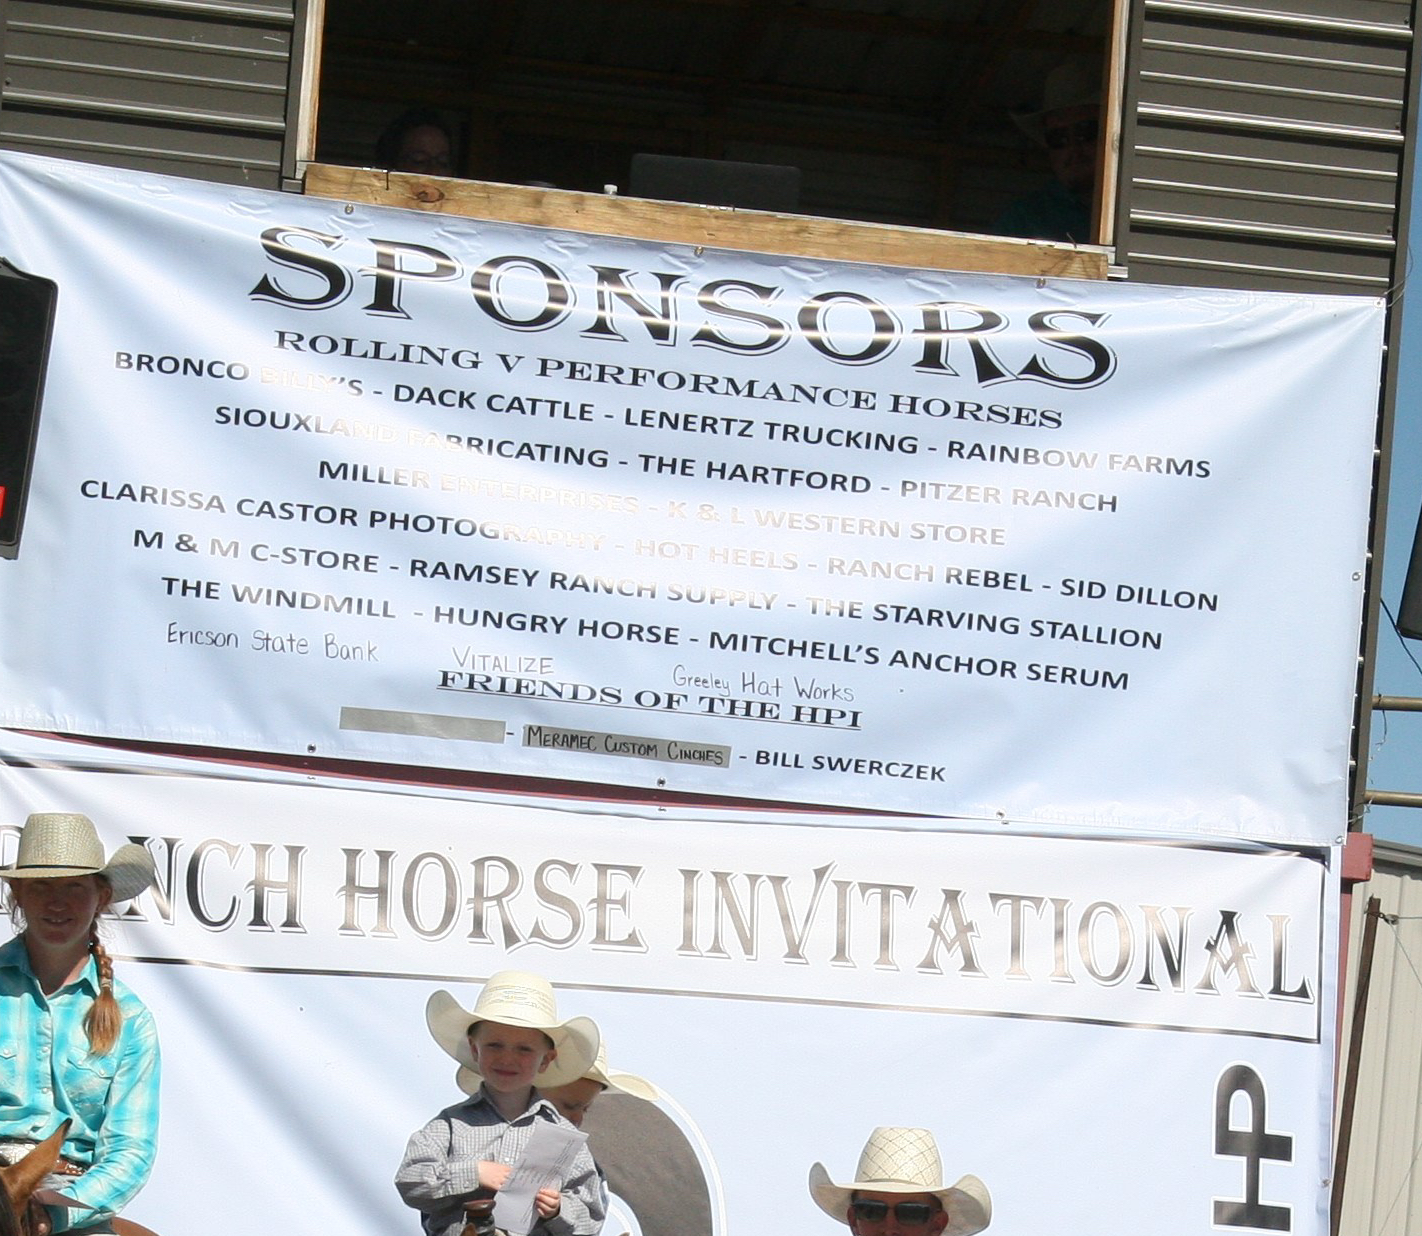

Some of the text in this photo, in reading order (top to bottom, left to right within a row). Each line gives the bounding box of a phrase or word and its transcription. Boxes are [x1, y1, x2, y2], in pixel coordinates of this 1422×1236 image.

[248, 226, 1119, 390] SPONSORS
[114, 349, 250, 384] BRONCO
[393, 382, 476, 412] DACK
[486, 392, 595, 423] CATTLE
[624, 406, 754, 439] LENERTZ
[762, 420, 920, 455] TRUCKING
[947, 438, 1098, 474] RAINBOW
[1108, 450, 1212, 481] FARMS
[273, 328, 1064, 432] ROLLING V PERFORMANCE HORSES
[213, 404, 398, 444] SIOUXLAND
[405, 427, 609, 470] FABRICATING
[638, 452, 696, 478] THE
[705, 459, 872, 496] HARTFORD
[900, 477, 1002, 508] PITZER
[1012, 484, 1118, 515] RANCH
[317, 459, 430, 490] MILLER
[668, 499, 687, 520] K
[697, 502, 721, 523] &
[731, 506, 745, 525] L
[753, 507, 900, 540] WESTERN
[910, 519, 1007, 550] STORE
[79, 477, 226, 513] CLARISSA
[235, 496, 359, 529] CASTOR
[368, 508, 606, 552] PHOTOGRAPHY
[635, 537, 700, 562] HOT
[709, 544, 799, 571] HEELS
[828, 554, 934, 585] RANCH
[945, 565, 1034, 594] REBEL
[1060, 576, 1107, 601] SID
[1115, 582, 1220, 613] DILLON
[133, 528, 164, 551] M
[174, 531, 199, 554] &
[209, 537, 240, 559] M
[250, 541, 380, 575] C-STORE
[409, 556, 540, 590] RAMSEY
[549, 570, 657, 600] RANCH
[666, 581, 778, 613] SUPPLY
[805, 596, 864, 621] THE
[872, 601, 1020, 637] STARVING
[1028, 618, 1163, 652] STALLION
[161, 575, 221, 601] THE
[231, 583, 397, 620] WINDMILL
[434, 603, 570, 637] HUNGRY
[578, 616, 681, 647] HORSE
[709, 629, 880, 666] MITCHELL'S
[887, 647, 1019, 681] ANCHOR
[1025, 661, 1130, 692] SERUM
[166, 619, 380, 664] Ericson State Bank
[452, 644, 555, 679] VITALIZE
[672, 662, 856, 705] Greeley Hat Works
[436, 668, 863, 729] FRIENDS OF THE HPI
[527, 724, 597, 752] MERAMEC
[604, 733, 658, 758] CUSTOM
[667, 740, 723, 765] CINCHES
[754, 748, 805, 770] BILL
[811, 753, 947, 784] SWERCZEK
[337, 847, 648, 953] HORSE
[676, 860, 1315, 1004] INVITATIONAL
